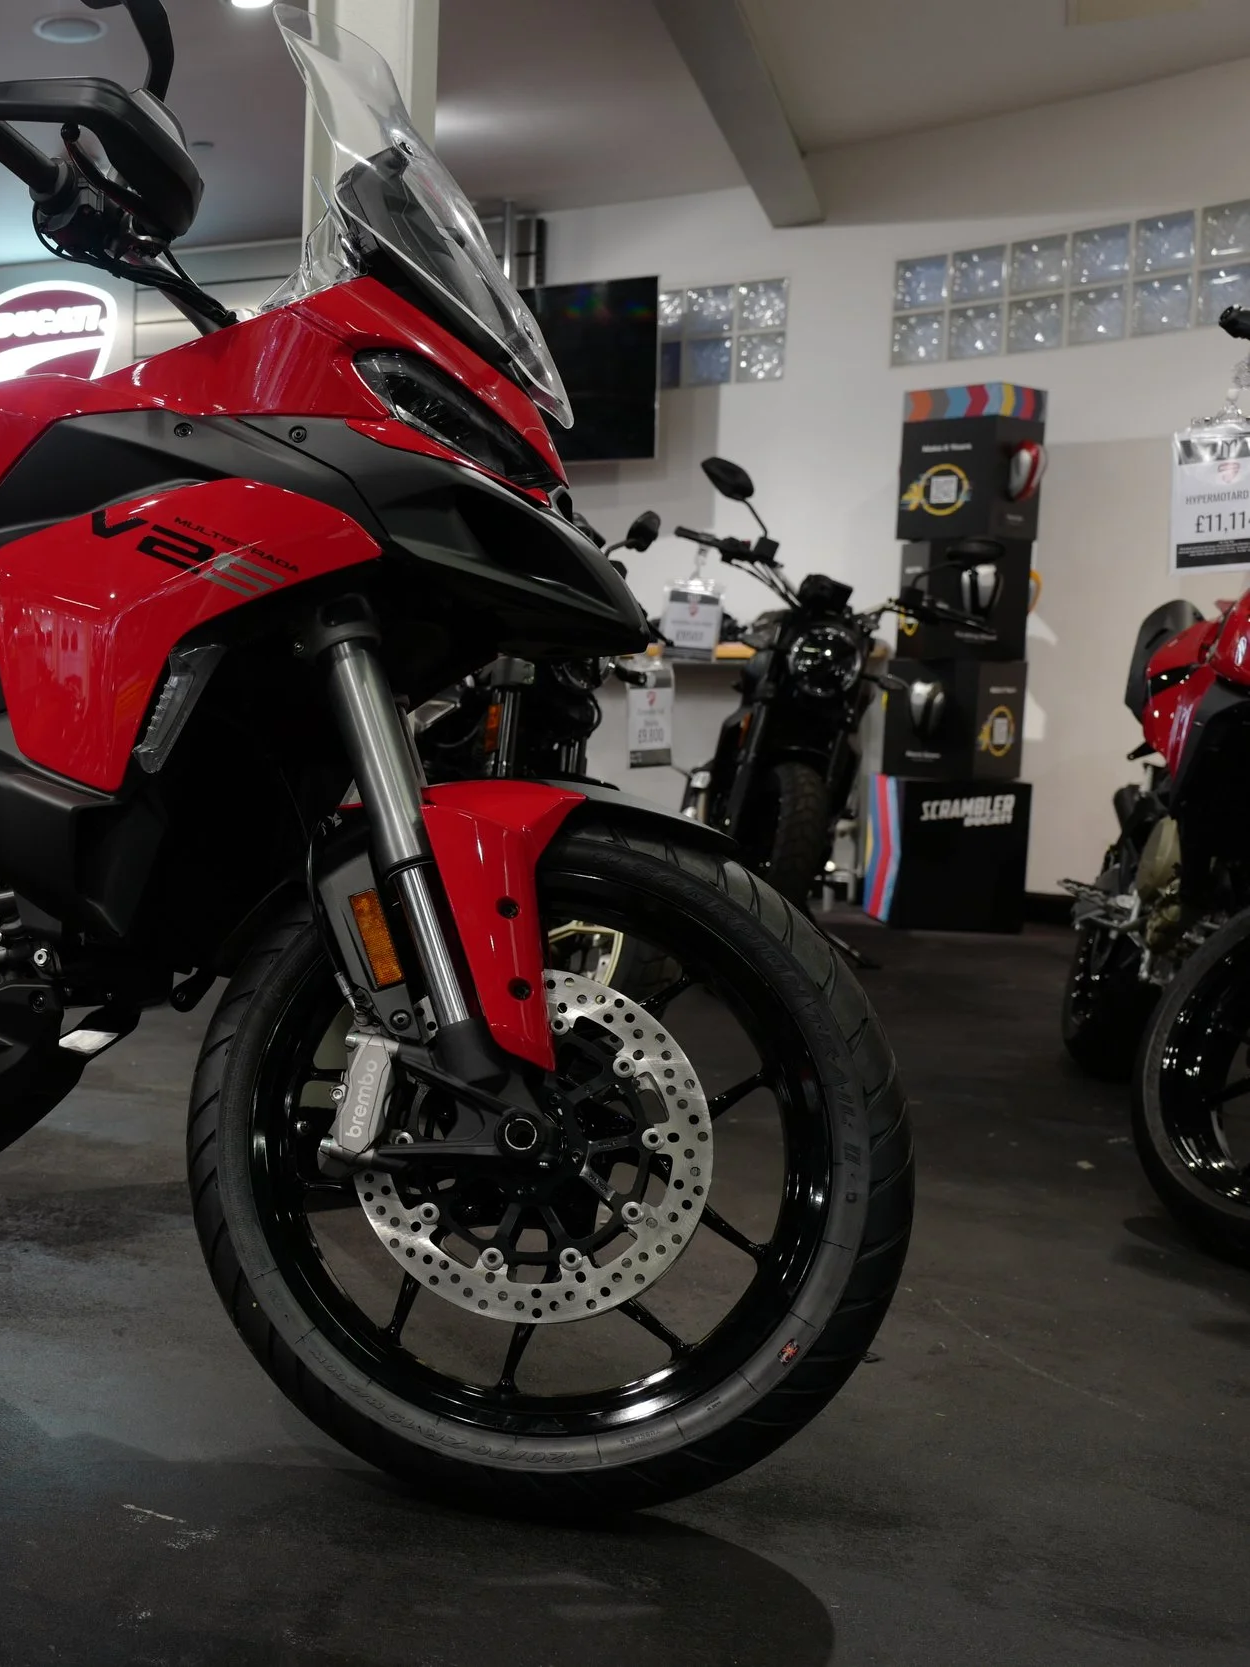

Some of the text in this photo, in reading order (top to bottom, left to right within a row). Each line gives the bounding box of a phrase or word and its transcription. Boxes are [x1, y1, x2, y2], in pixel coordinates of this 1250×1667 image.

[1185, 490, 1249, 505] HYPERMOTARD
[1195, 511, 1250, 534] £11,11
[174, 516, 299, 573] MULTISTRADA
[919, 793, 1016, 821] SCRAMBLER
[963, 813, 1013, 827] DUCATI
[345, 1060, 378, 1138] brembo
